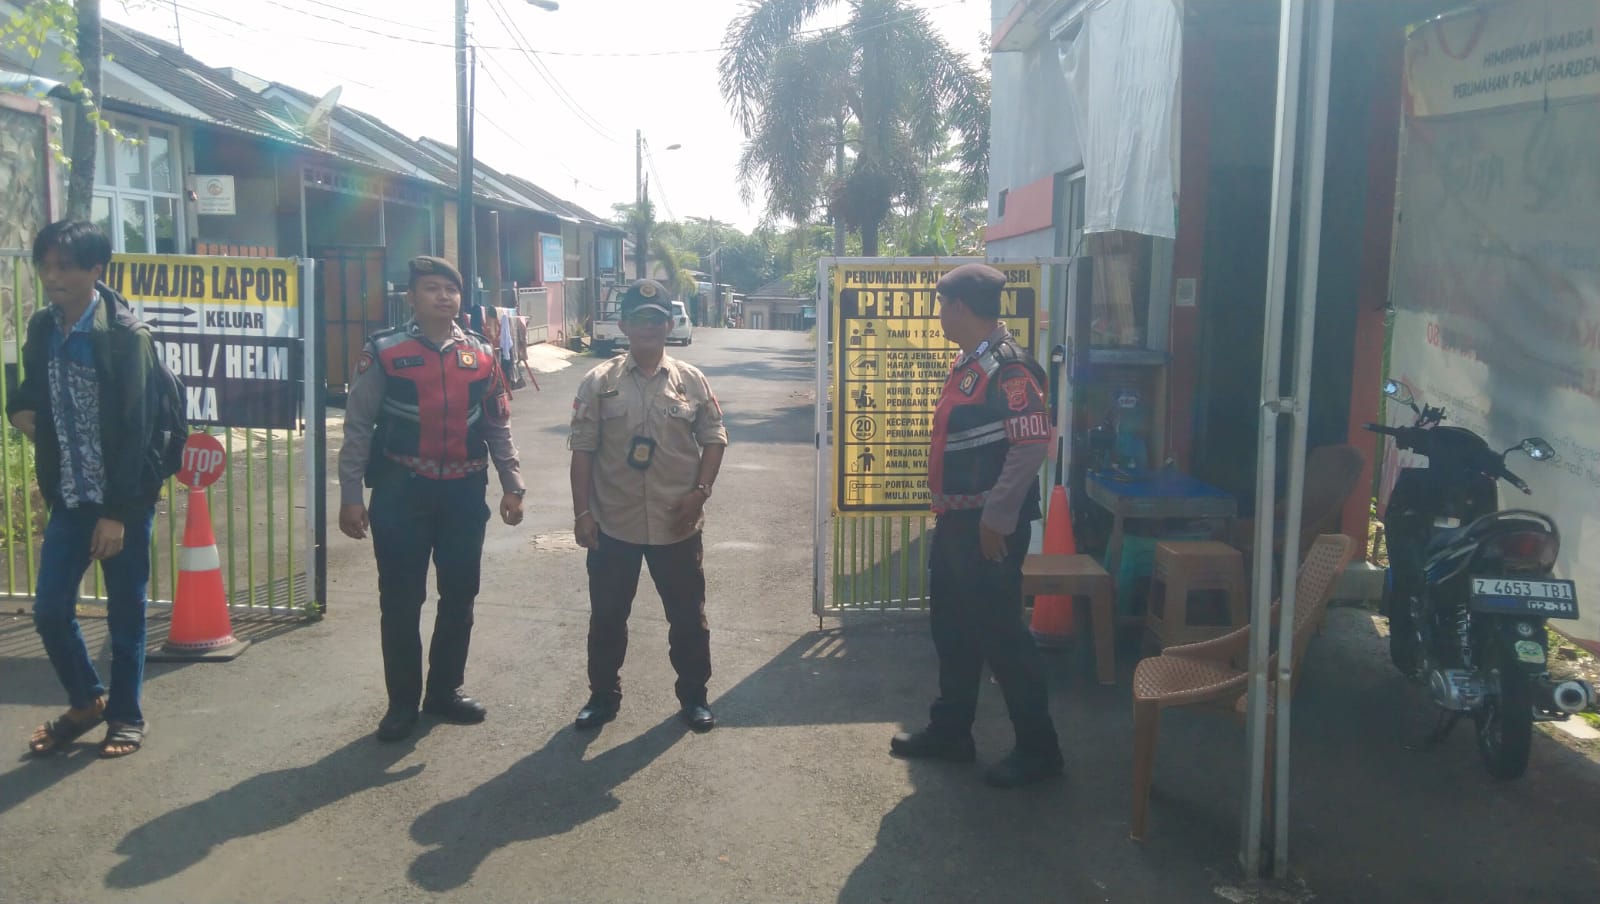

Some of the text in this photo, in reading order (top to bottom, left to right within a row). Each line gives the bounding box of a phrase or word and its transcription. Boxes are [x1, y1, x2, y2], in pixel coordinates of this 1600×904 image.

[1545, 29, 1593, 52] WARGA
[1453, 74, 1509, 99] PERUMAHAN
[1512, 66, 1544, 88] PALM
[845, 271, 916, 284] PERUMAHAN
[131, 263, 205, 298] WAJIB
[212, 266, 287, 302] LAPOR
[206, 311, 264, 329] KELUAR
[887, 330, 910, 338] TAMU
[914, 330, 918, 338] 1
[929, 330, 940, 338] 24
[887, 352, 908, 360] KACA
[911, 352, 947, 360] JENDELA
[208, 343, 220, 378] /
[225, 345, 289, 380] HELM
[887, 361, 914, 369] HARAP
[917, 361, 947, 369] DIBUKA
[887, 370, 946, 378] LAMPU UTAMA
[887, 387, 913, 396] KURIR,
[886, 399, 928, 407] PEDAGANG
[856, 419, 871, 432] 20
[886, 418, 929, 426] KECEPATAN
[886, 449, 922, 457] MENJAGA
[886, 460, 910, 469] AMAN,
[885, 480, 914, 489] PORTAL
[885, 491, 910, 500] MULAI
[1476, 581, 1486, 594] Z
[1494, 582, 1532, 596] 4653
